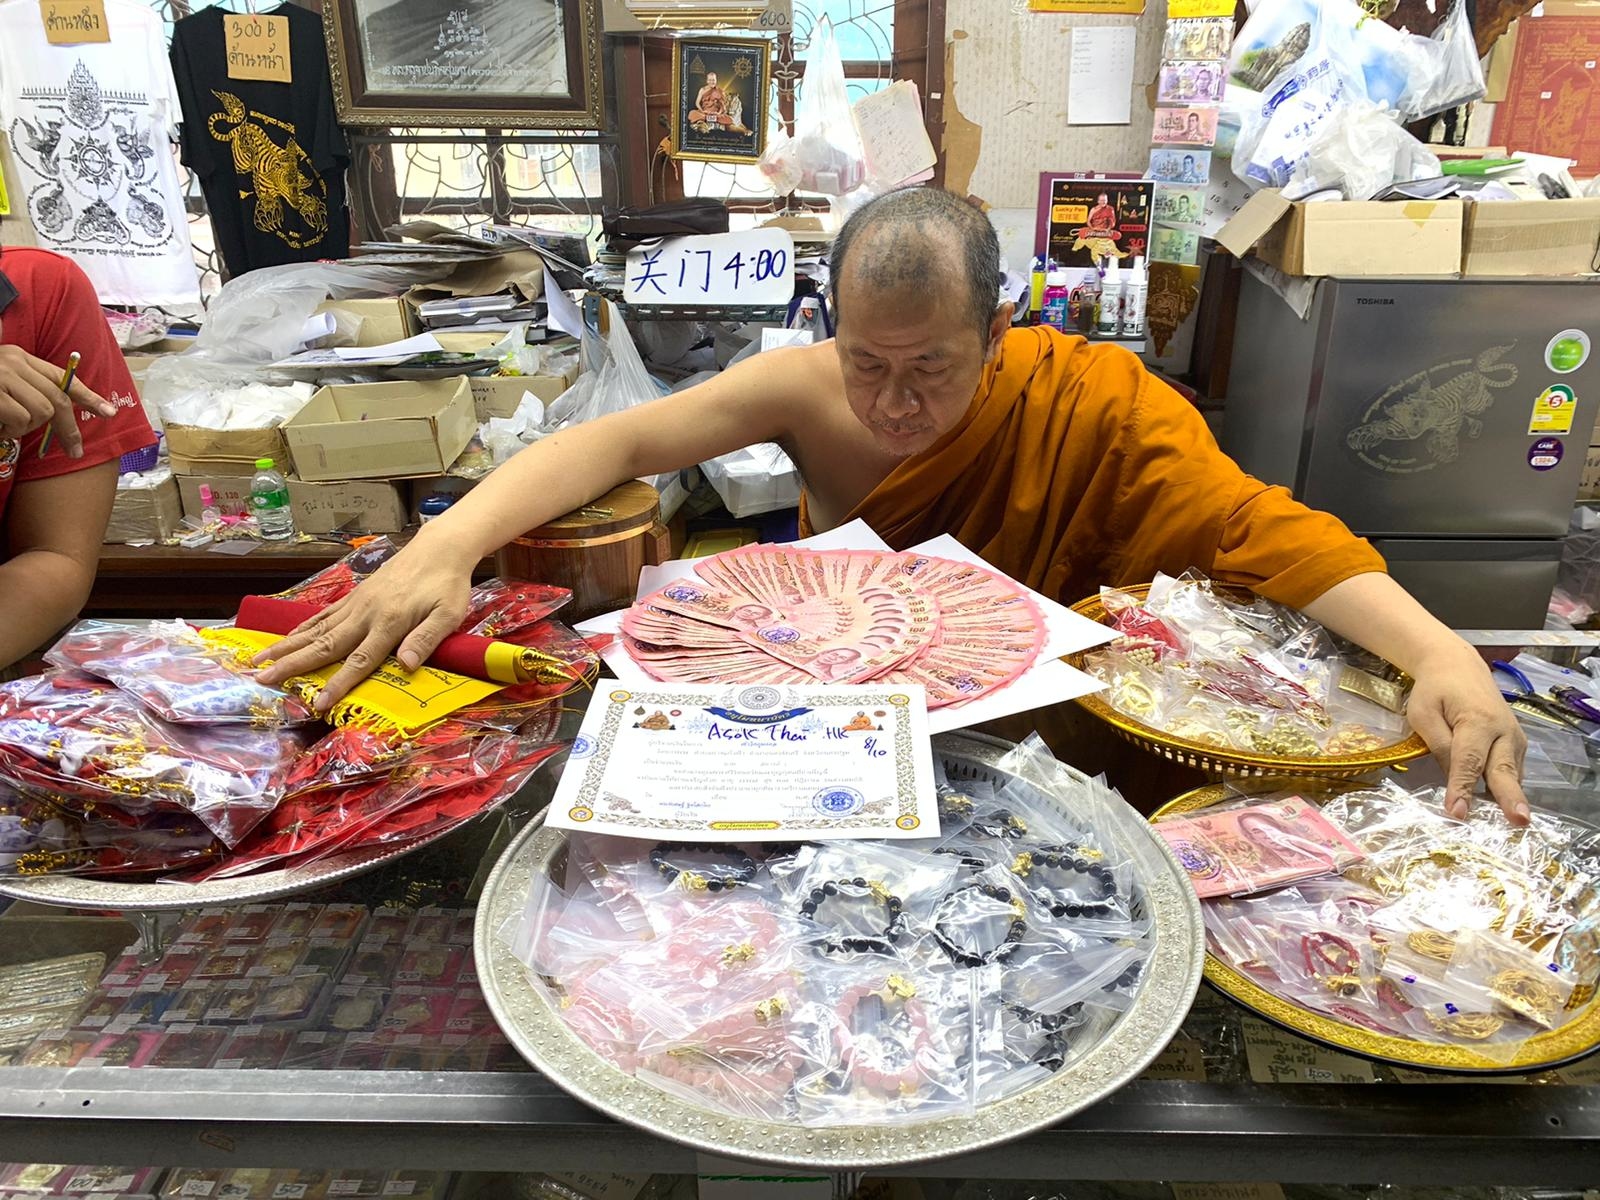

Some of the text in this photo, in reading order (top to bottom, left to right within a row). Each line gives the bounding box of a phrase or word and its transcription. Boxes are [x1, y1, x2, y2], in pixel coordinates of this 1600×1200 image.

[233, 21, 261, 38] 300
[229, 43, 285, 71] ด้านหน้า
[631, 249, 711, 294] 关门
[1356, 297, 1395, 305] TOSHIBA
